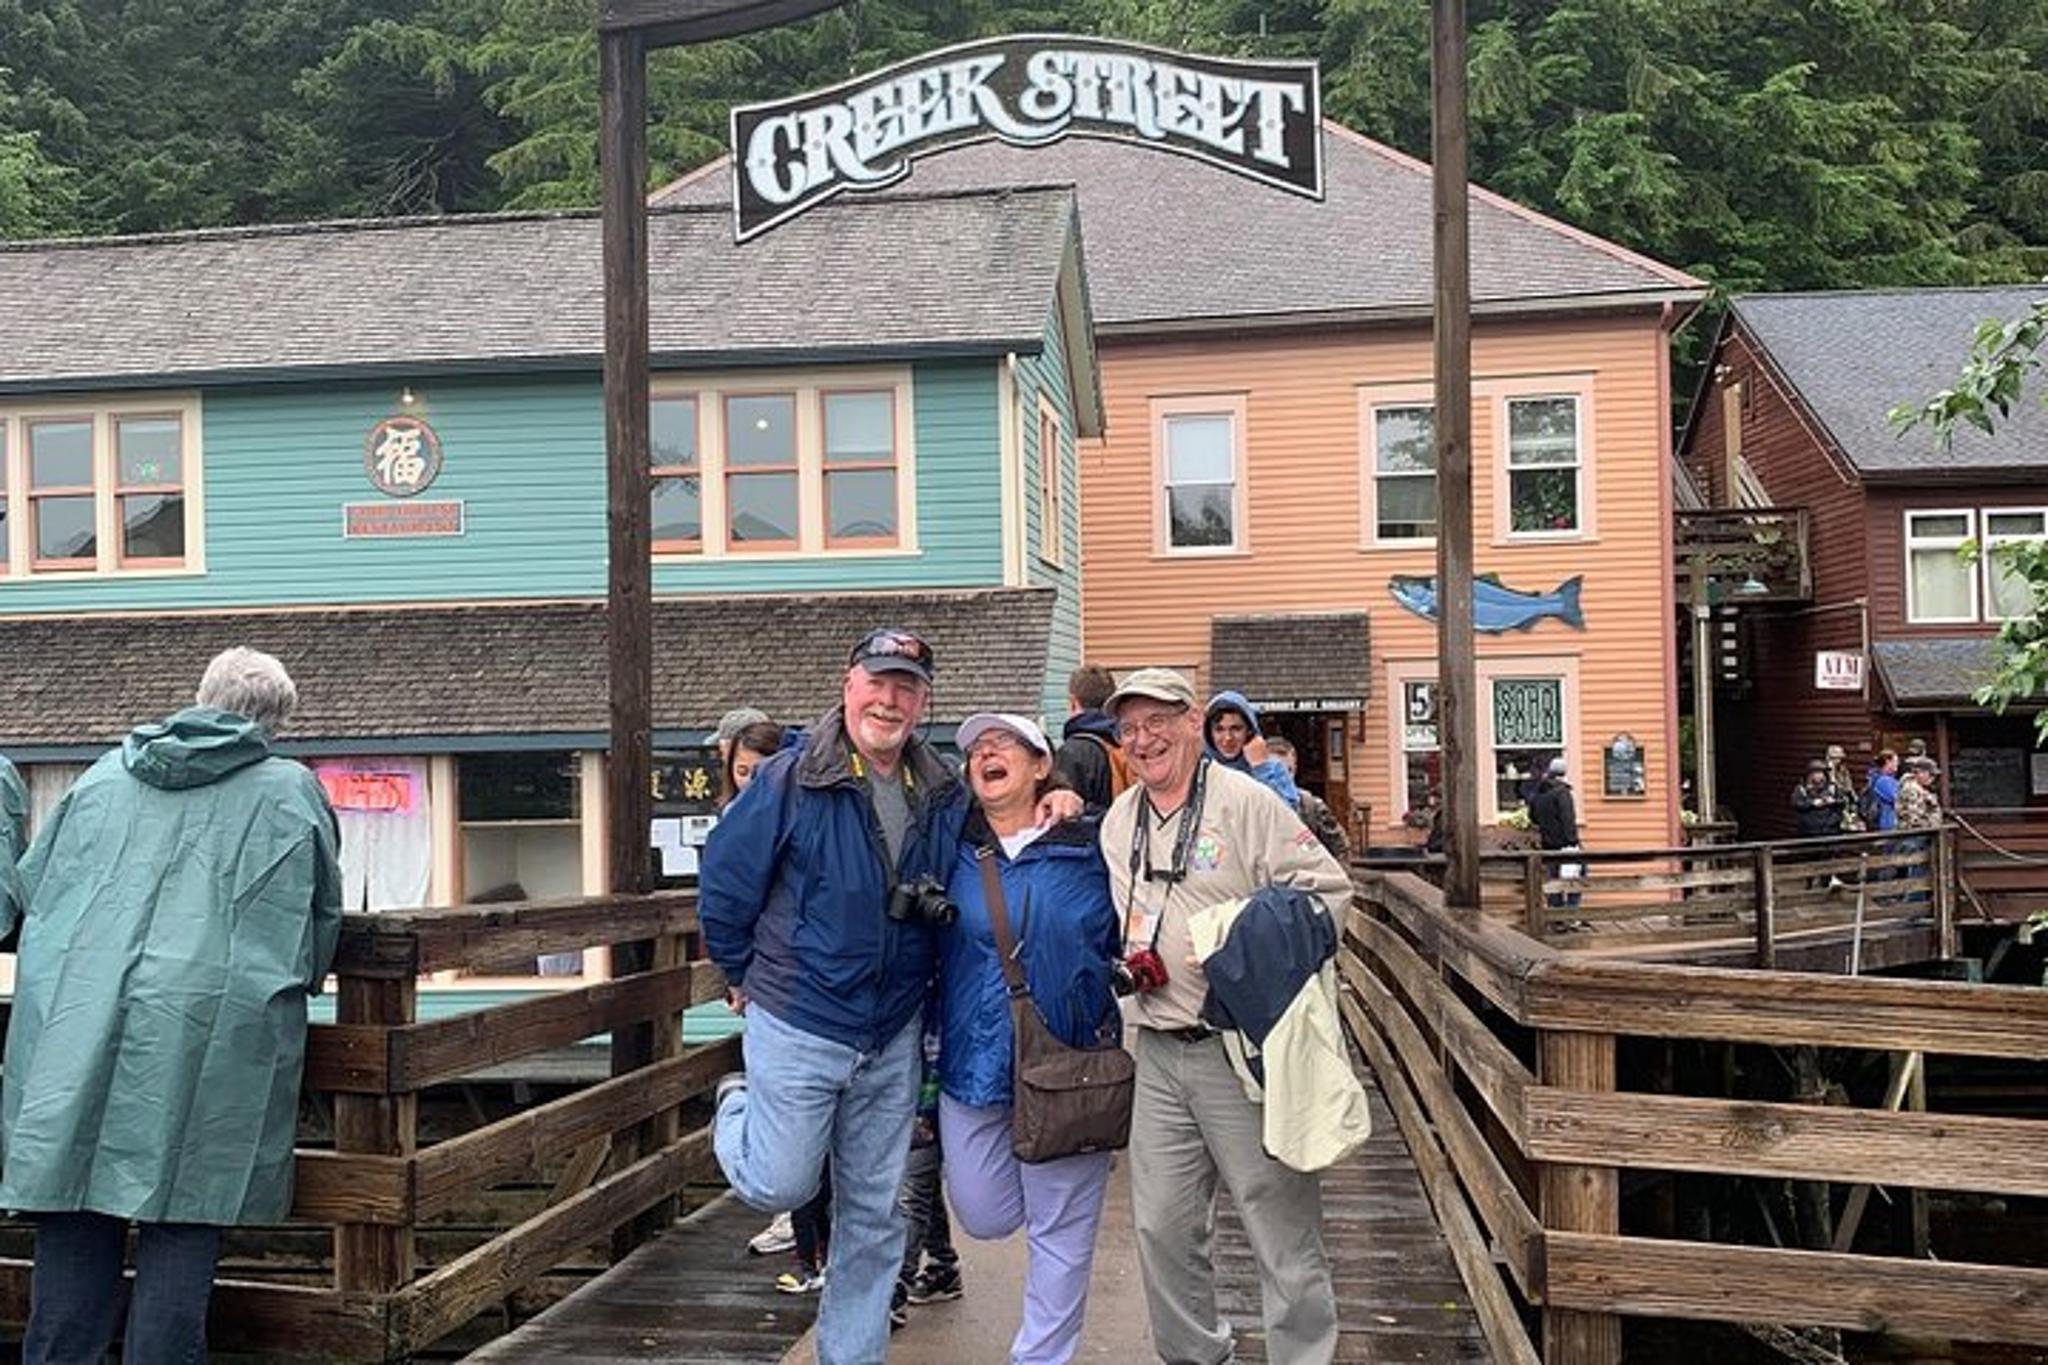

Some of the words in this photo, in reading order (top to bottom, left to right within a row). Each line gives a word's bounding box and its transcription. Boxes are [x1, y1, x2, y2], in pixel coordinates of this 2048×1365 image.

[746, 54, 1072, 203] CREEK
[1020, 51, 1305, 169] STREET
[375, 426, 426, 493] 福
[1497, 682, 1557, 712] SOHO
